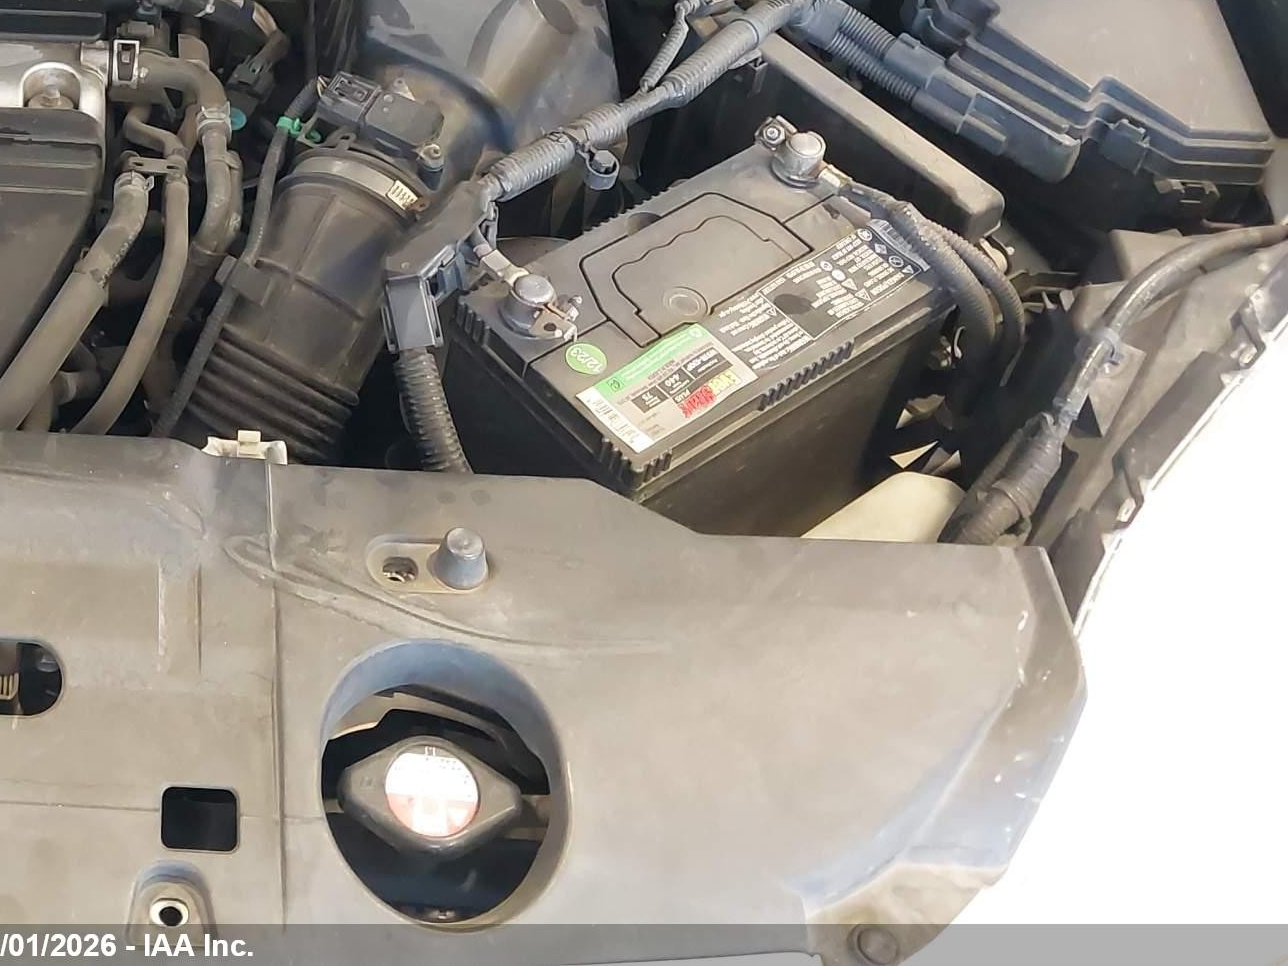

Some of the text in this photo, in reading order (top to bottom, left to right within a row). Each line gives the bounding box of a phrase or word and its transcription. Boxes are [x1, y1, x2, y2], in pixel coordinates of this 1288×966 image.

[569, 345, 602, 374] 12/23
[663, 372, 680, 387] 440
[673, 388, 690, 403] PLUS
